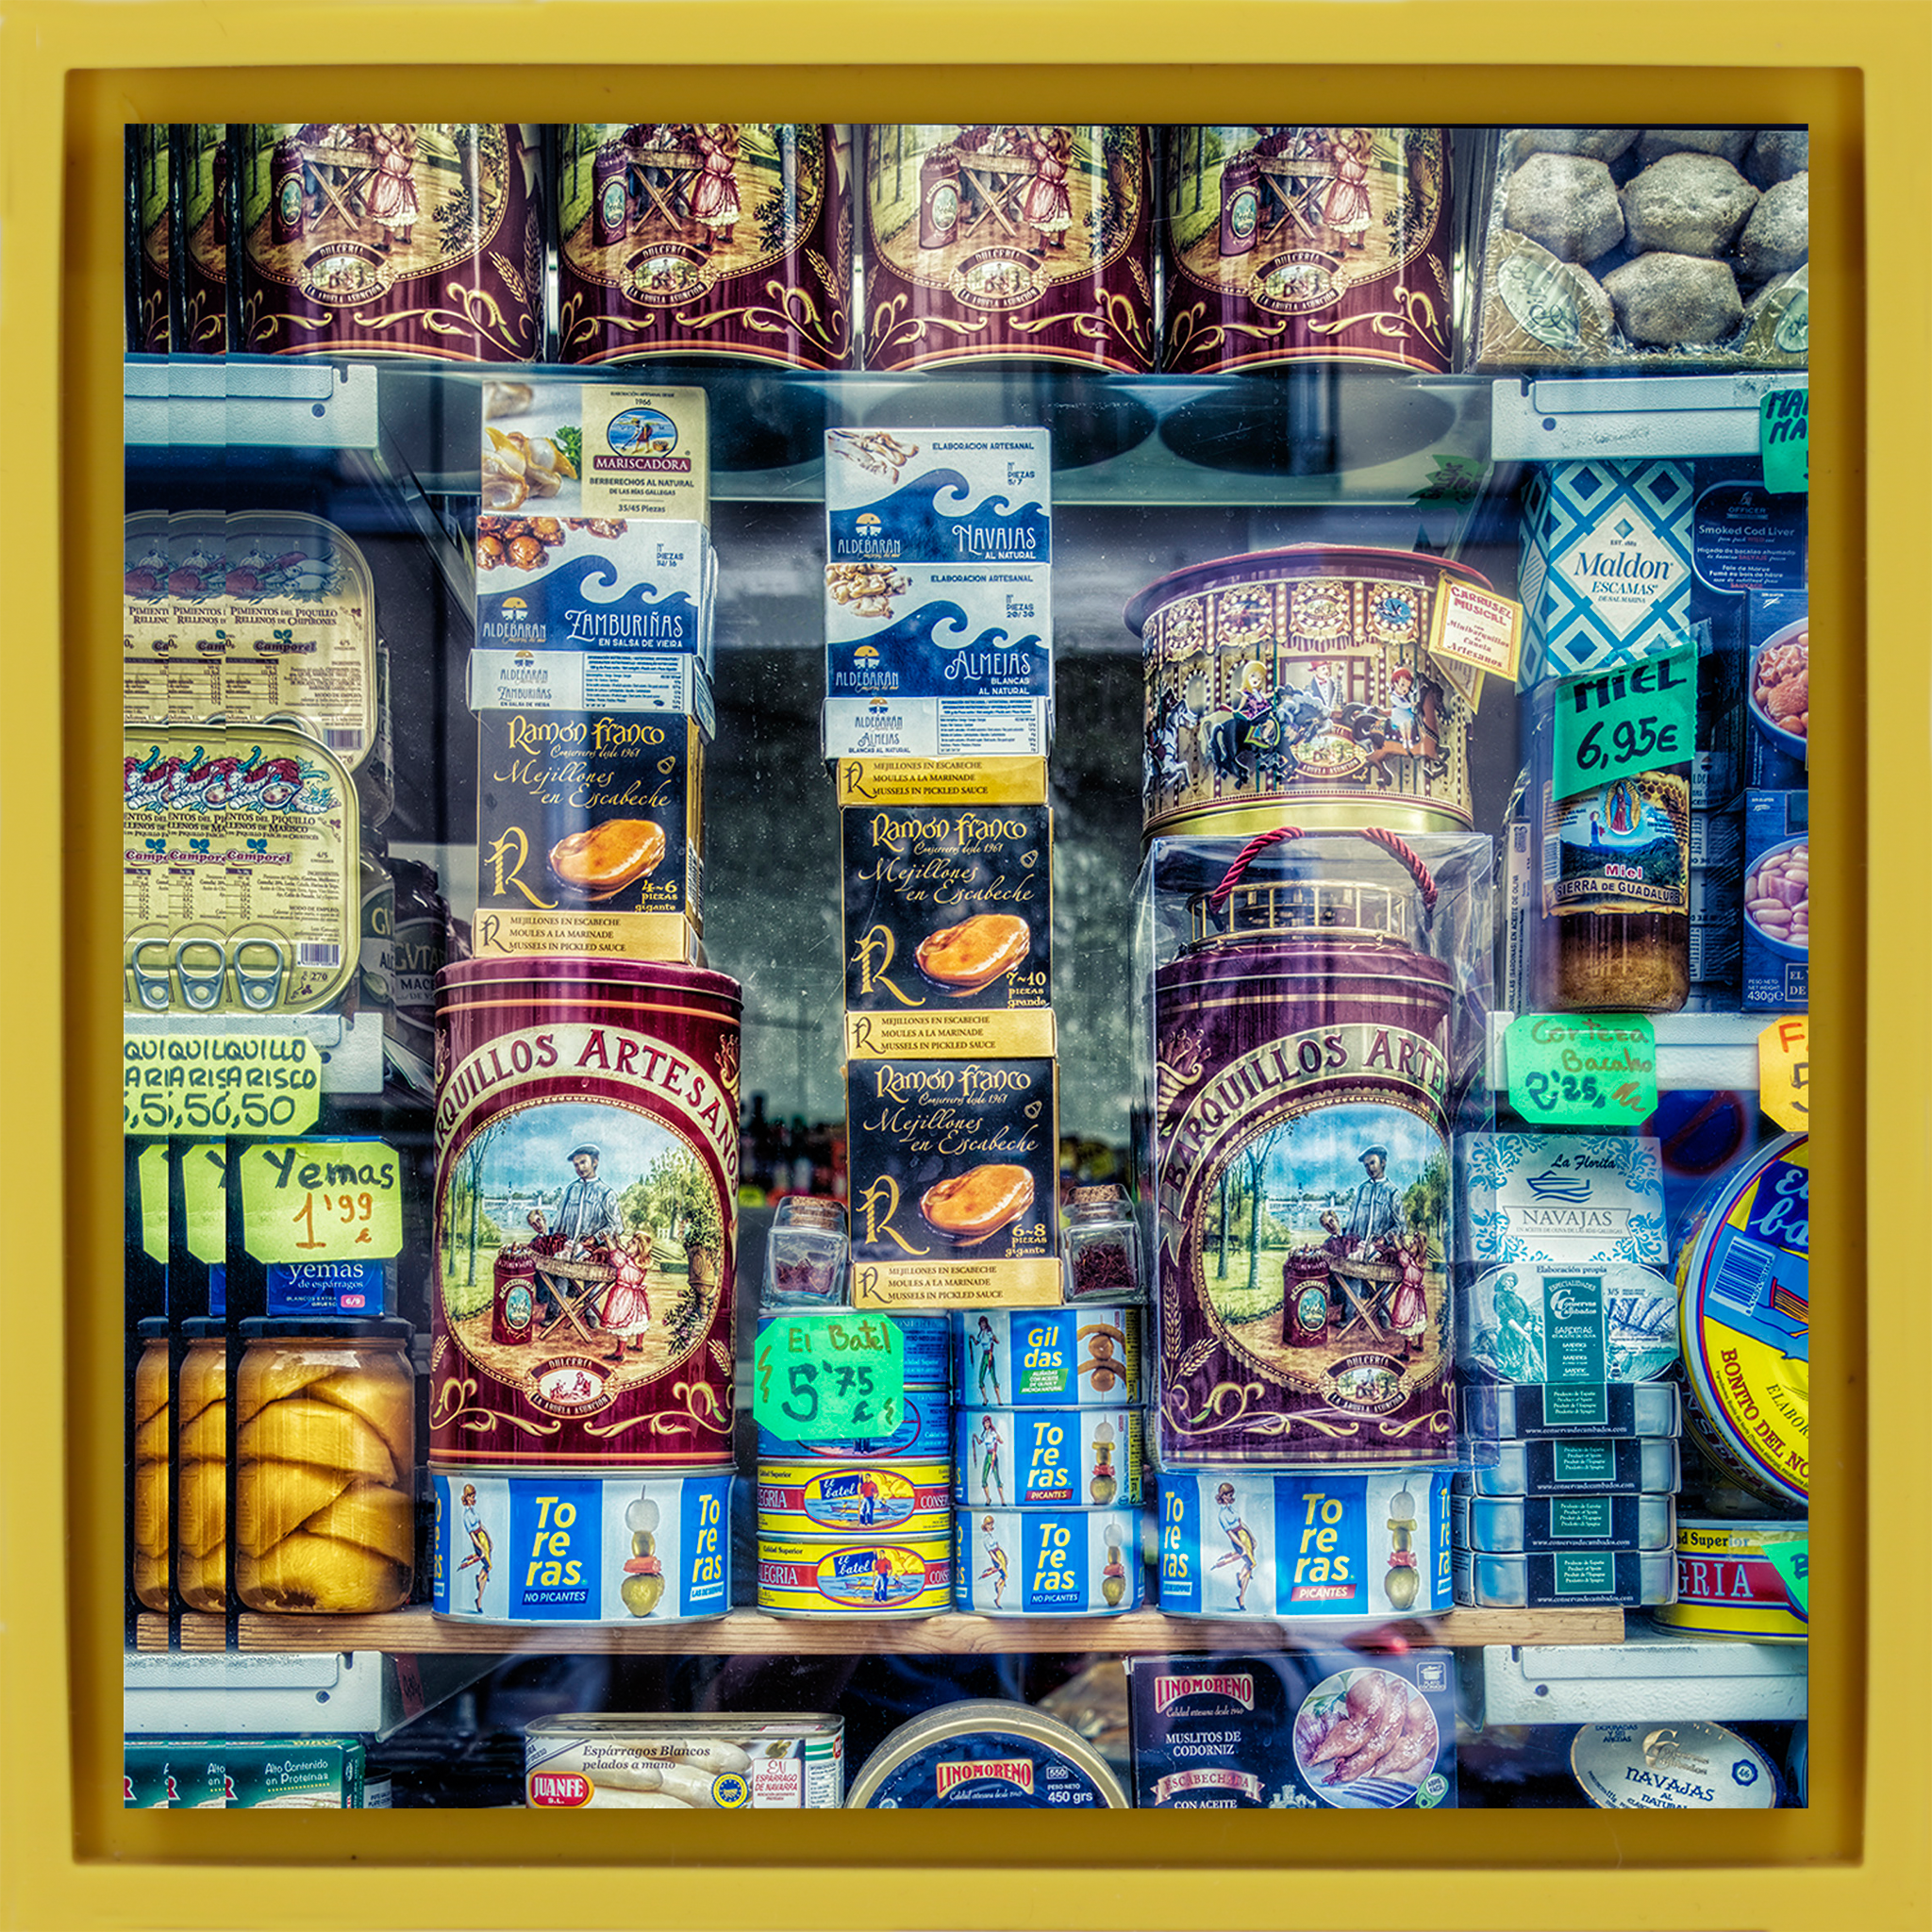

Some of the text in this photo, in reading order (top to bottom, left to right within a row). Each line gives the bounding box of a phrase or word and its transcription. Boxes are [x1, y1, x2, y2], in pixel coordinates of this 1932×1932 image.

[595, 458, 689, 471] MARISCADORA
[590, 477, 645, 487] BERBERECHOS
[641, 505, 666, 513] Piezas
[1698, 525, 1794, 536] Smoked Cod Liver
[1574, 552, 1670, 580] Maldon
[1591, 581, 1654, 595] ESCAMAS
[1451, 587, 1511, 619] CARRUSEL
[1455, 598, 1507, 625] MUSICAL
[565, 608, 683, 642] ZAMBURIÑAS
[255, 641, 317, 654] Camporel
[1448, 642, 1502, 667] Artesanos
[944, 651, 1030, 680] ALMEJAS
[508, 715, 587, 755] Ramón
[936, 761, 982, 770] ESCABECHE
[493, 759, 614, 794] Mejillones
[929, 774, 975, 782] MARINADE
[541, 780, 671, 808] en Escabeche
[272, 815, 315, 826] PIQUILLO
[870, 813, 949, 852] Ramón
[858, 858, 978, 892] Mejillones
[1605, 864, 1643, 879] Miel
[907, 874, 1035, 905] en Escabeche
[1557, 880, 1598, 896] SIERRA
[1601, 883, 1615, 891] DE
[1790, 986, 1806, 995] DE
[874, 1064, 954, 1103] Ramón
[863, 1108, 983, 1142] Mejillones
[911, 1124, 1040, 1155] en Escabeche
[261, 1147, 394, 1190] Yemas
[1551, 1154, 1618, 1171] La Florita
[1523, 1209, 1612, 1228] NAVAJAS
[288, 1263, 364, 1286] yemas
[1583, 1267, 1607, 1275] propia
[298, 1278, 363, 1291] de espárragos
[828, 1320, 891, 1354] Batel
[1028, 1326, 1058, 1347] Gil
[1024, 1349, 1062, 1368] das
[1721, 1348, 1759, 1421] BONITO
[1754, 1420, 1786, 1458] DEL
[1034, 1423, 1063, 1445] To
[1032, 1448, 1059, 1466] re
[1027, 1468, 1068, 1488] ras
[825, 1484, 856, 1498] batel
[1031, 1491, 1066, 1499] PICANTES
[536, 1496, 577, 1528] To
[1302, 1493, 1342, 1524] To
[532, 1531, 571, 1557] re
[1300, 1528, 1338, 1554] re
[1690, 1532, 1750, 1548] Superior
[525, 1559, 582, 1587] ras
[839, 1559, 870, 1574] batel
[1294, 1557, 1350, 1583] ras
[525, 1591, 585, 1603] NO PICANTES
[1042, 1594, 1078, 1603] PICANTES
[1299, 1587, 1348, 1597] PICANTES
[1165, 1731, 1241, 1745] MUSLITOS DE
[582, 1745, 710, 1758] Espárragos Blancos
[1173, 1744, 1235, 1757] CODORNIZ
[265, 1759, 328, 1774] Alto Contenido
[582, 1759, 625, 1772] pelados
[641, 1761, 675, 1770] mano
[1049, 1769, 1066, 1777] 550
[265, 1777, 278, 1786] en
[532, 1777, 584, 1799] JUANFE
[755, 1783, 798, 1791] DE NAVARRA
[1624, 1766, 1715, 1802] NAVAJAS
[1048, 1791, 1093, 1804] 450 grs
